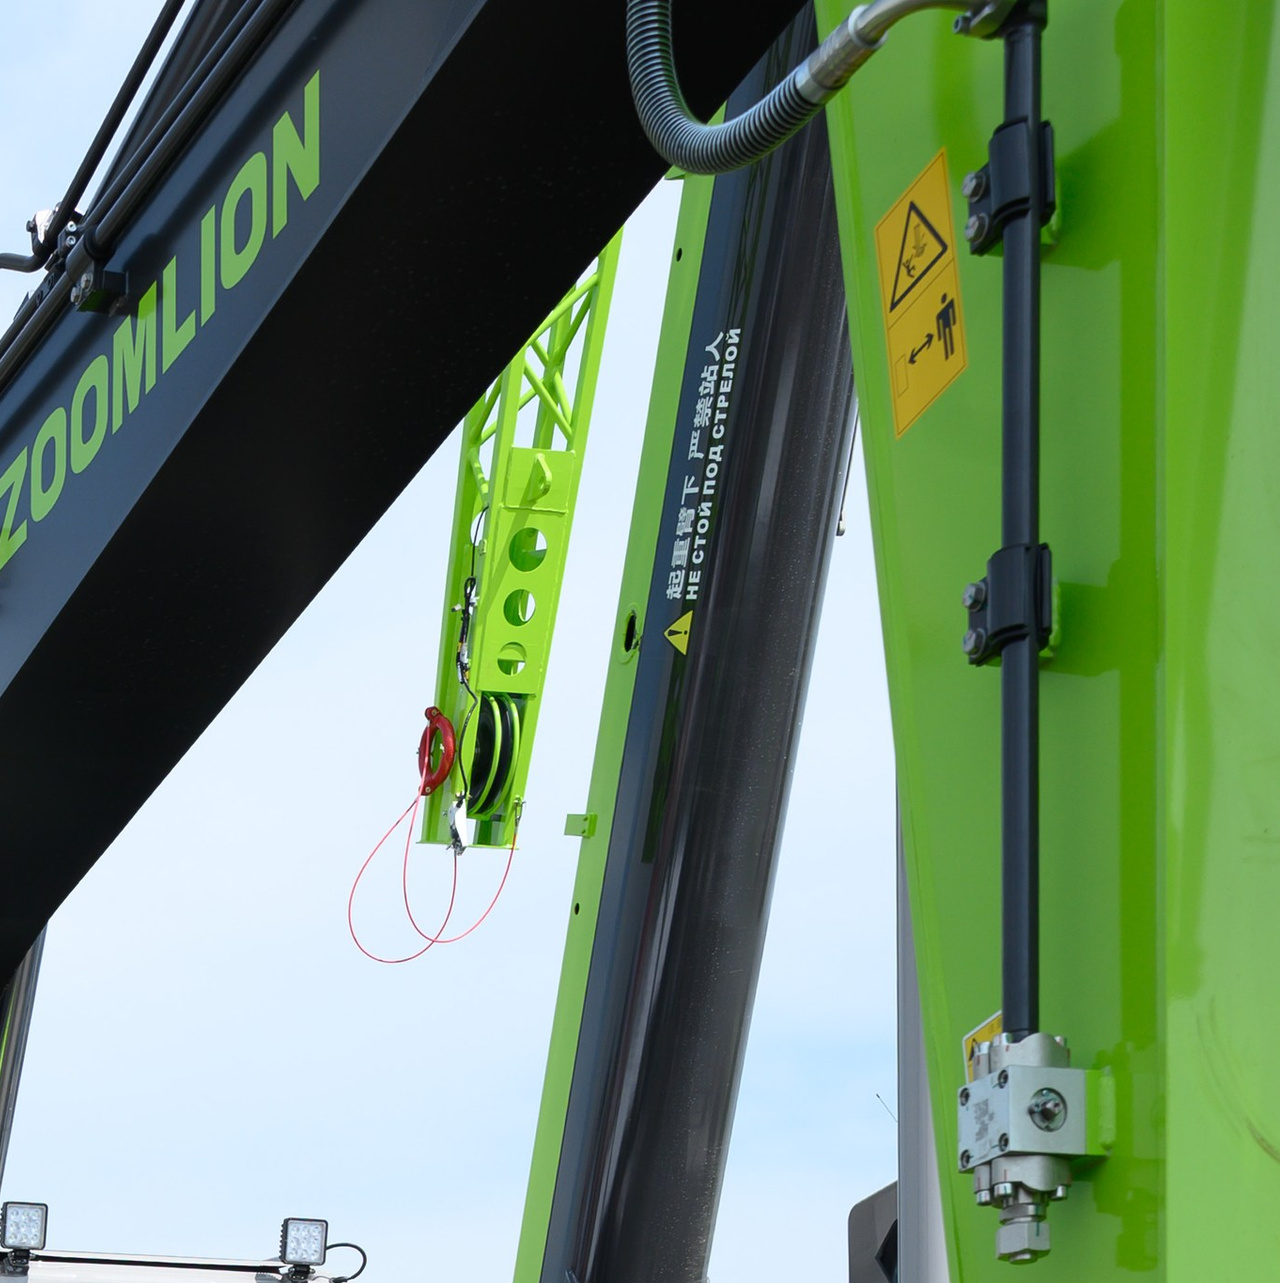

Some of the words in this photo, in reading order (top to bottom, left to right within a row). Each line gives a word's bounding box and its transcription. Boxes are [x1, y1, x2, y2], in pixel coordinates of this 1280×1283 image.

[713, 329, 741, 438] СТРЕЛОЙ
[666, 475, 699, 600] 起重臂下
[688, 332, 724, 460] 严禁站人
[703, 445, 724, 494] ПОД
[694, 502, 713, 561] СТОЙ
[686, 570, 701, 600] НЕ
